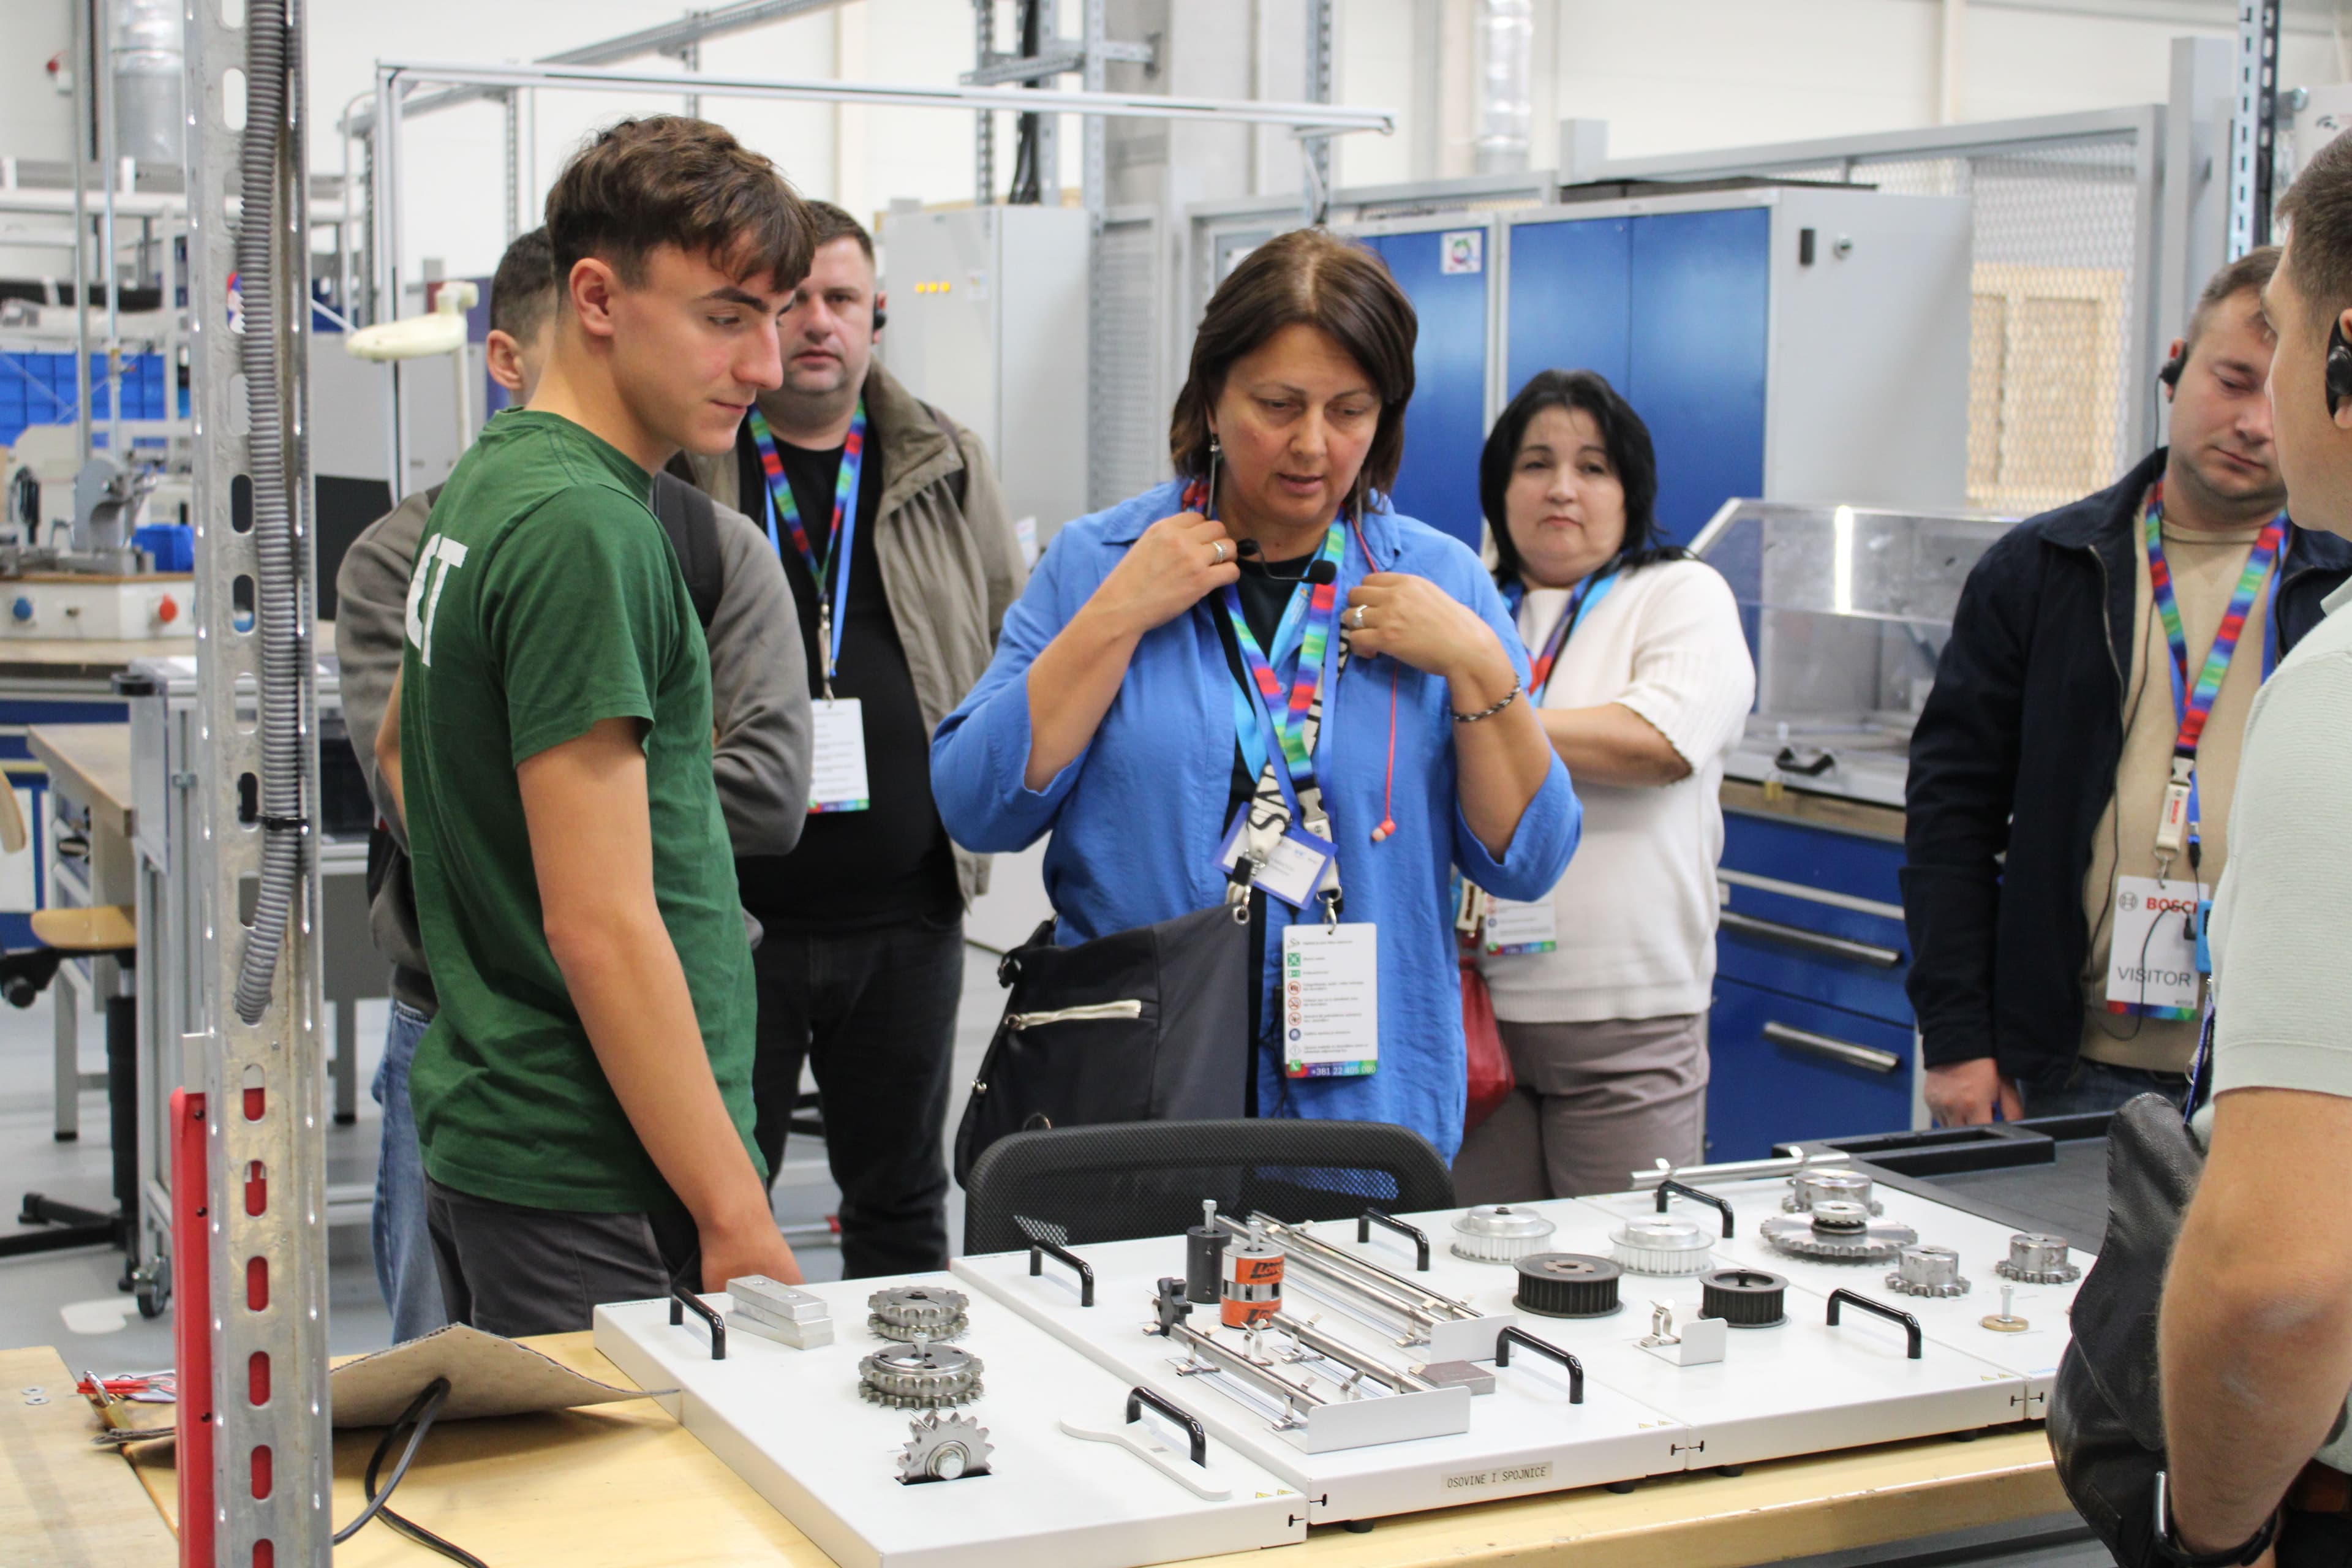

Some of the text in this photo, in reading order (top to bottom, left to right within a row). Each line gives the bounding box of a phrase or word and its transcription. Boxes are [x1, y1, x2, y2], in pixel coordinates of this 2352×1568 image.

[2117, 966, 2192, 987] VISITOR
[1447, 1466, 1547, 1488] OSOVINE I SPOJNICE
